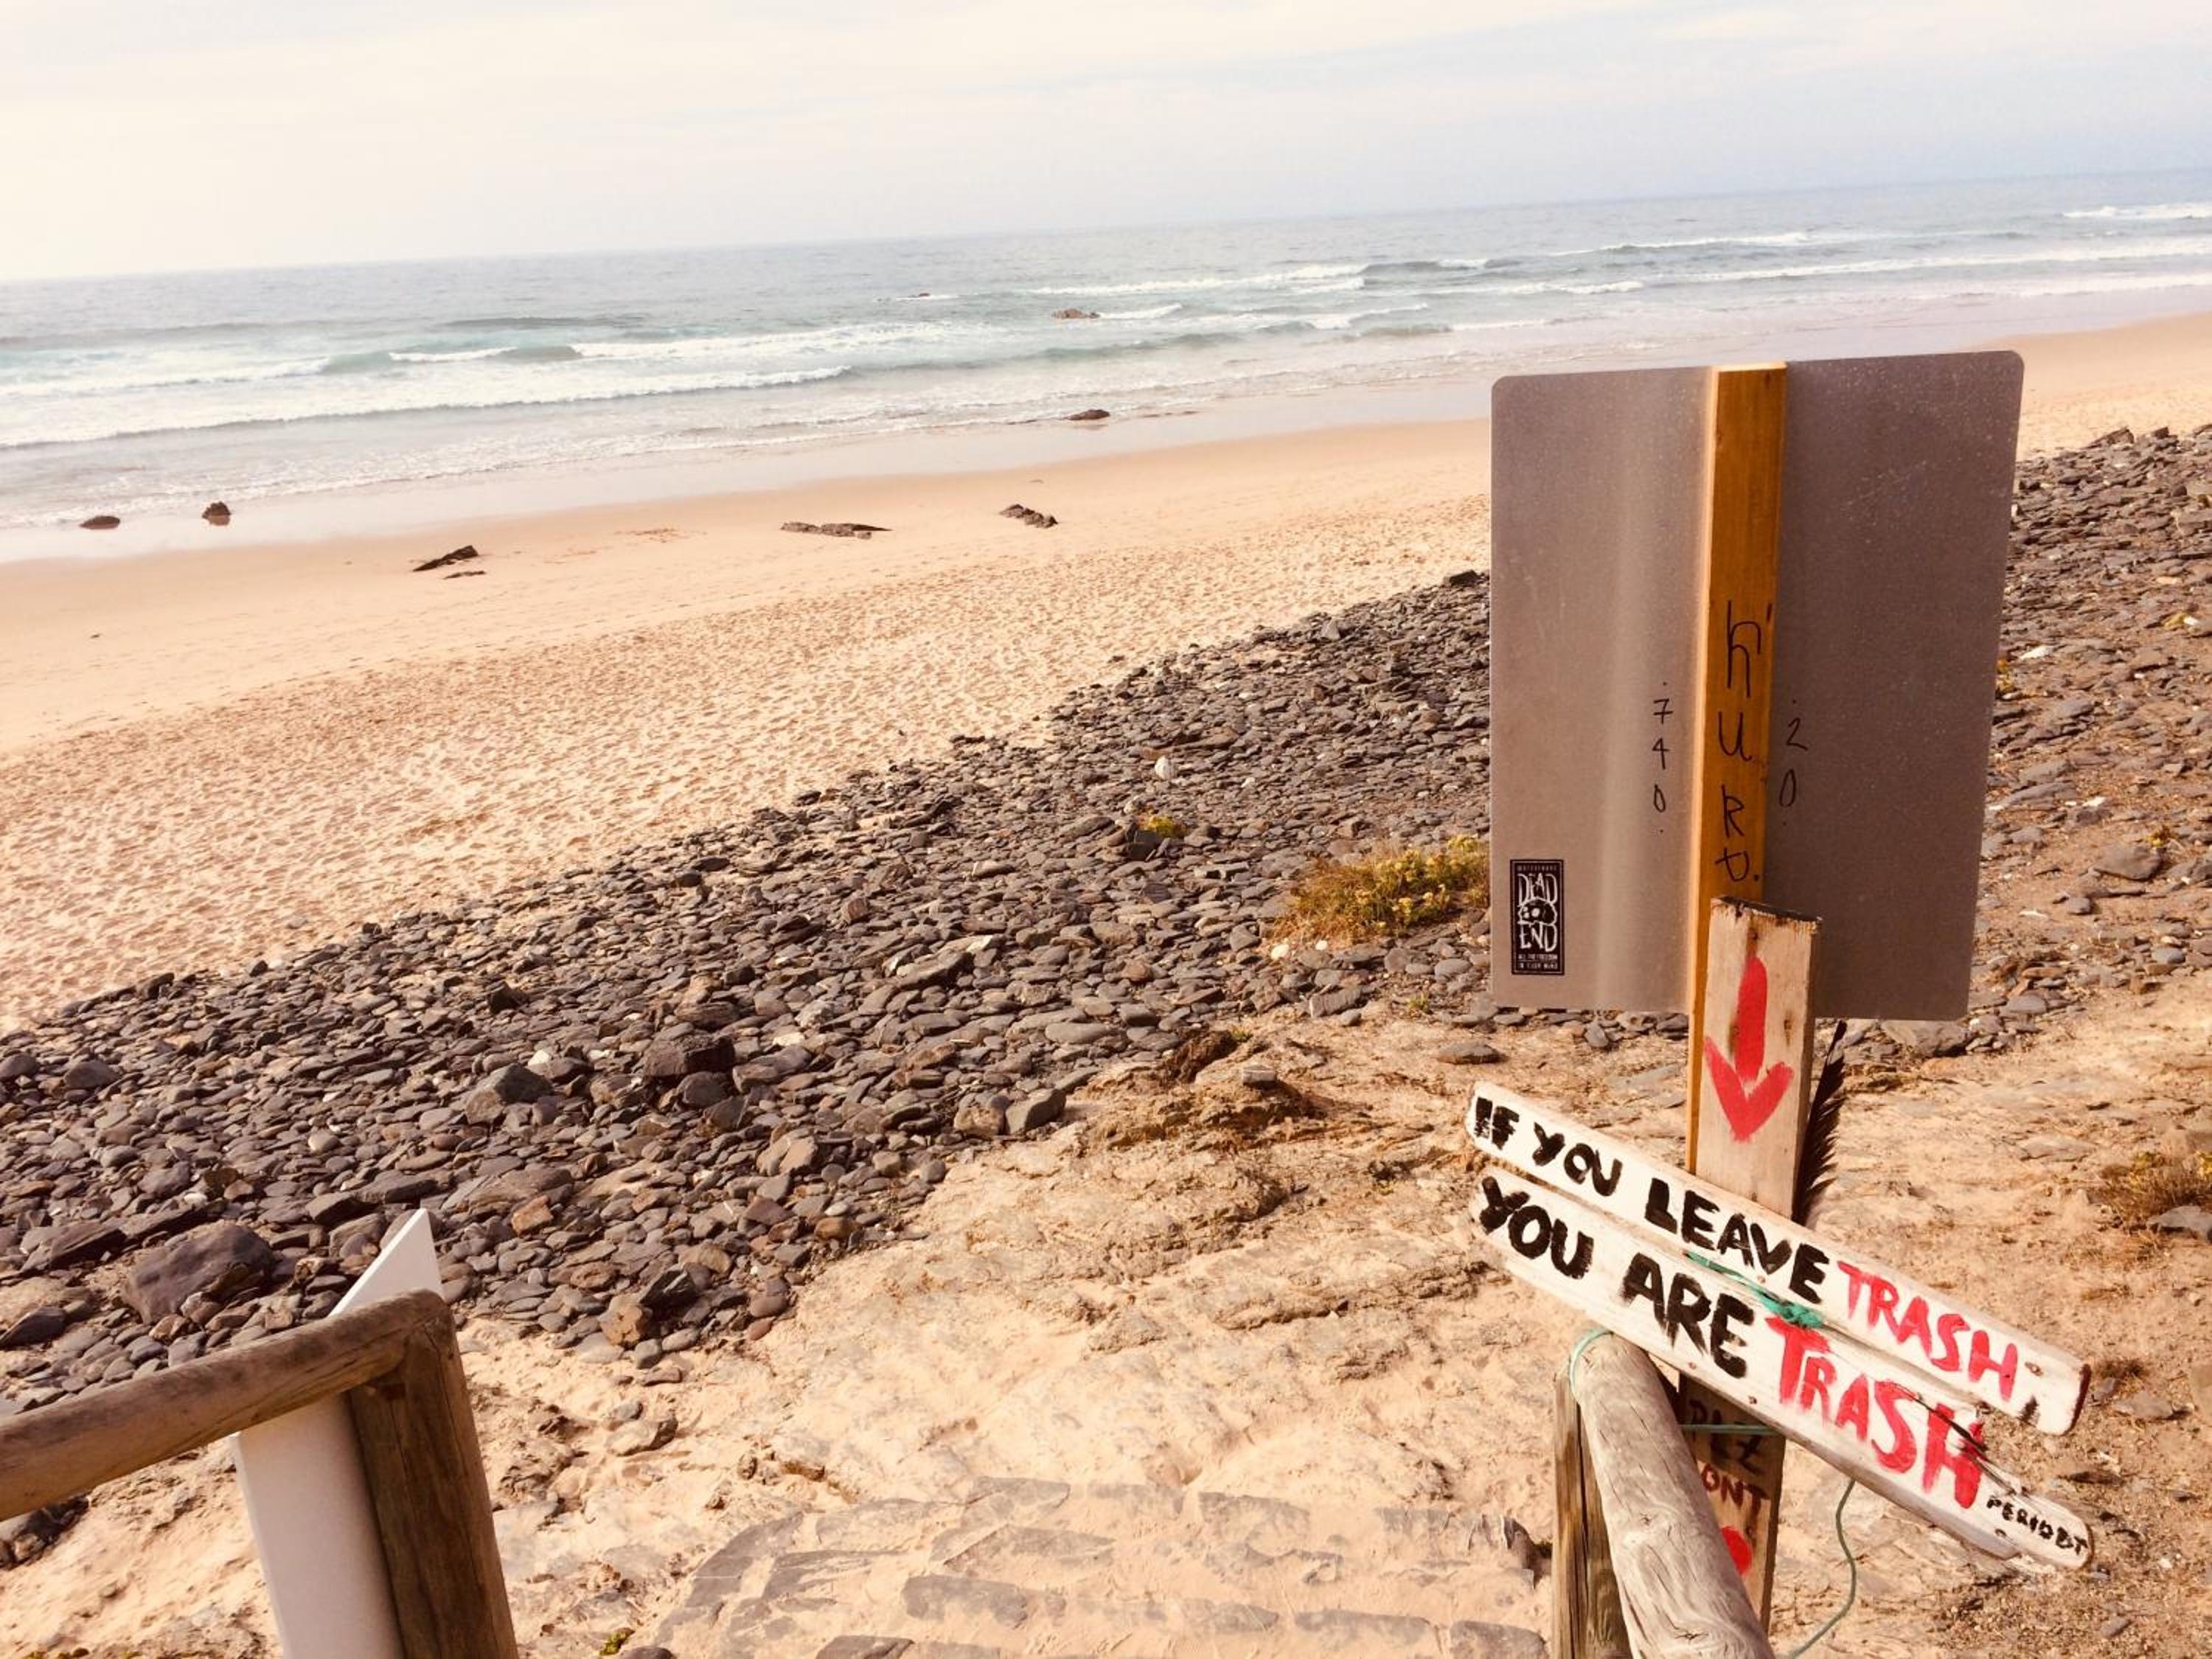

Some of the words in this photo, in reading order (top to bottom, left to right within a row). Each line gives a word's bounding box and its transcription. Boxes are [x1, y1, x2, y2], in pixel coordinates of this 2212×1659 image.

[1517, 872, 1558, 907] DEAD
[1517, 920, 1558, 952] END
[1474, 1096, 1520, 1151] IF
[1532, 1121, 1623, 1197] YOU
[1644, 1178, 1830, 1304] LEAVE
[1479, 1176, 1594, 1280] YOU
[1619, 1252, 1755, 1379] ARE
[1764, 1315, 1985, 1509] TRASH
[1702, 1462, 1770, 1534] ONT
